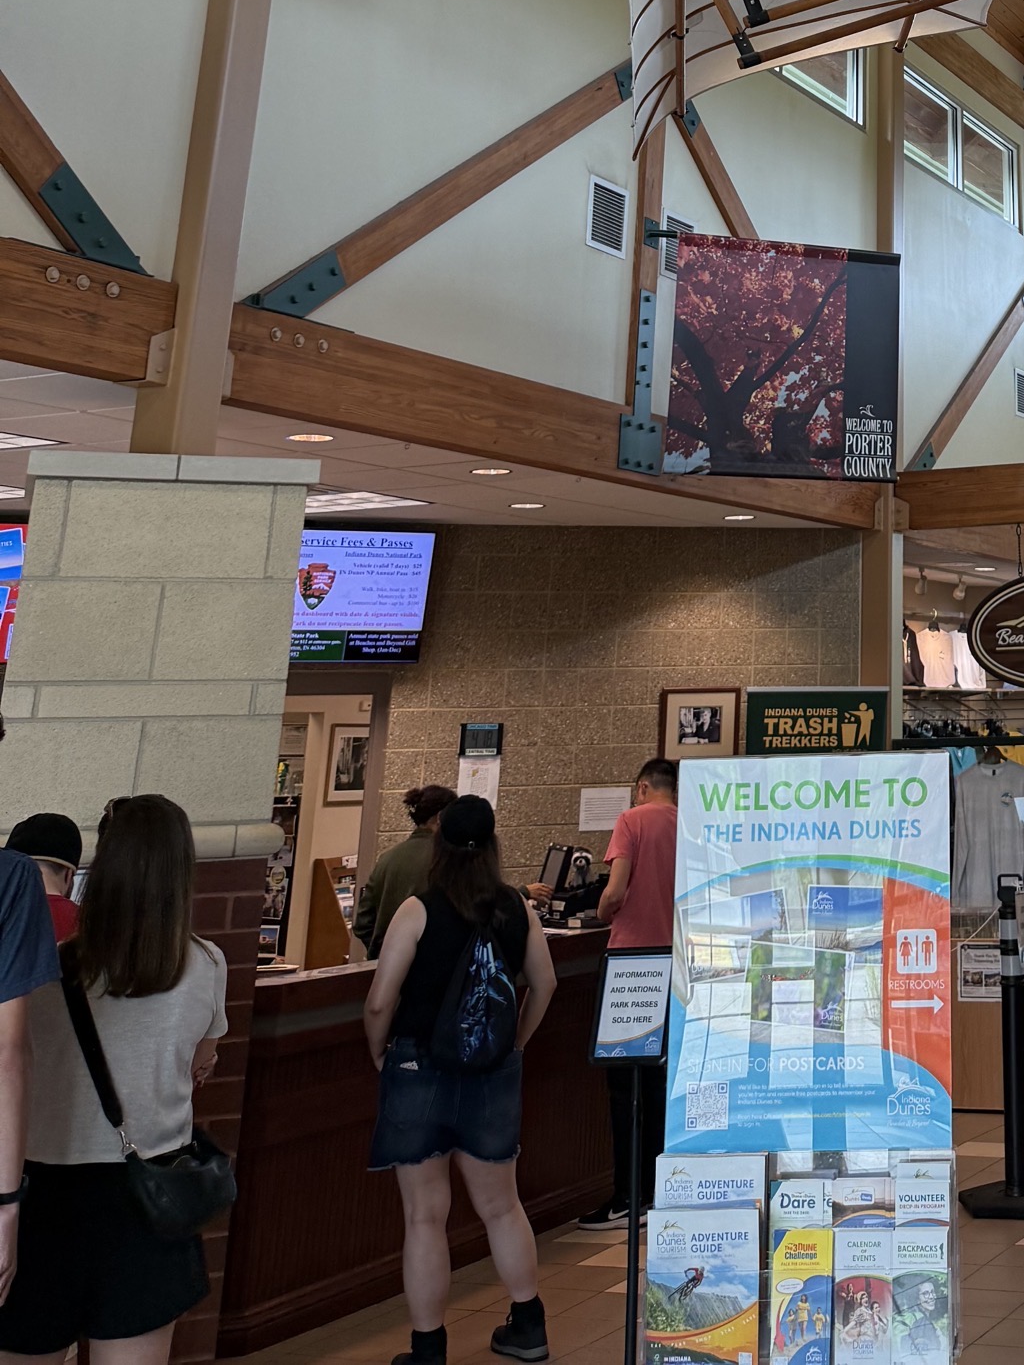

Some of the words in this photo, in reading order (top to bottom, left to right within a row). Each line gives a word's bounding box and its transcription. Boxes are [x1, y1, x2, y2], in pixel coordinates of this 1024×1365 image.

[845, 417, 881, 432] WELCOME
[882, 419, 893, 433] TO
[845, 433, 892, 456] PORTER
[843, 456, 892, 478] COUNTY
[341, 537, 363, 546] Fees
[367, 537, 376, 547] &
[380, 537, 413, 548] Passes
[764, 708, 803, 716] INDIANA
[806, 708, 838, 716] DUNES
[763, 717, 838, 735] TRASH
[763, 735, 838, 748] TREKKERS
[699, 779, 871, 812] WELCOME
[883, 777, 928, 808] TO
[703, 823, 743, 843] THE
[751, 821, 842, 842] INDIANA
[850, 819, 922, 840] DUNES
[888, 979, 945, 990] RESTROOMS
[687, 1058, 742, 1073] SIGN-IN
[748, 1057, 775, 1072] FOR
[780, 1056, 865, 1071] POSTCARDS
[901, 1095, 930, 1104] Indiana
[887, 1097, 931, 1116] Dunes
[665, 1180, 693, 1192] Dunes
[697, 1179, 754, 1189] ADVENTURE
[697, 1191, 728, 1200] GUIDE
[780, 1193, 816, 1209] Dare
[899, 1194, 945, 1202] VOLUNTEER
[657, 1234, 686, 1246] Dunes
[691, 1232, 749, 1242] ADVENTURE
[657, 1246, 686, 1254] TOURISM
[691, 1243, 722, 1253] GUIDE
[785, 1252, 817, 1260] Challenge
